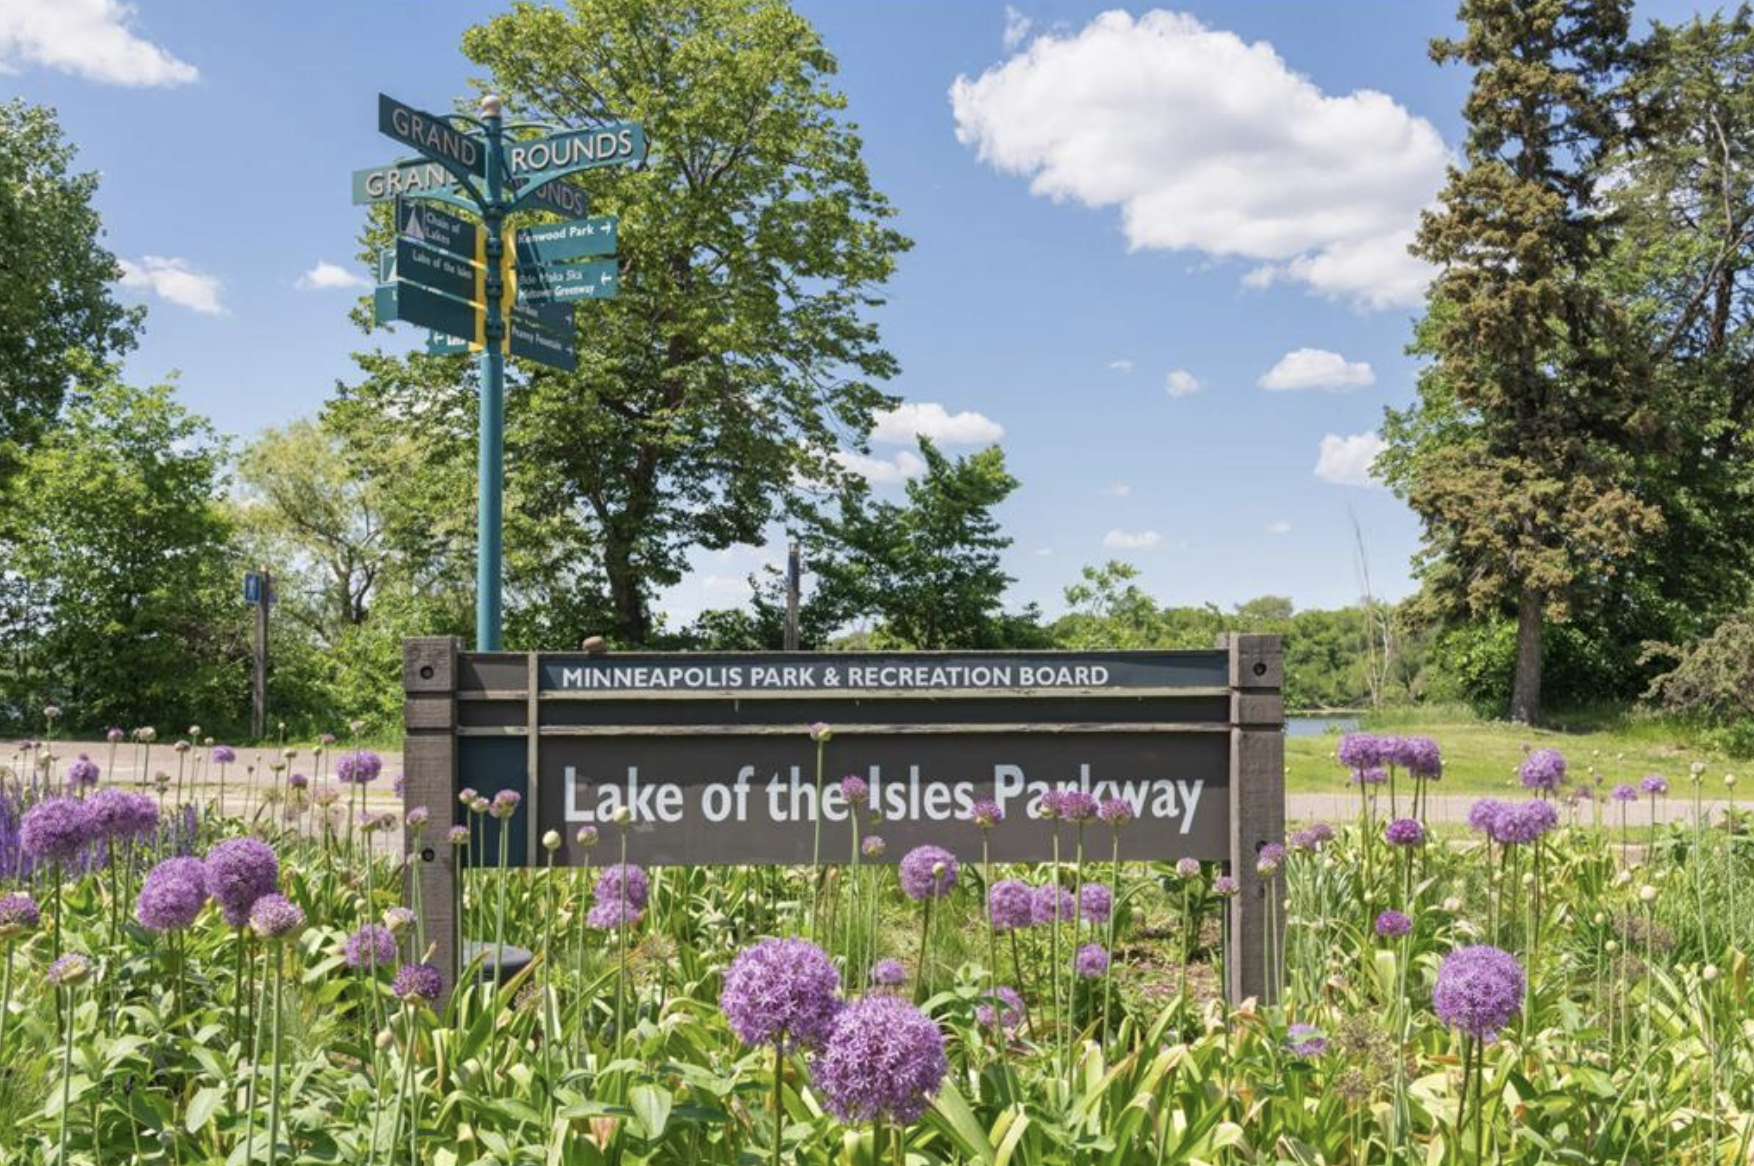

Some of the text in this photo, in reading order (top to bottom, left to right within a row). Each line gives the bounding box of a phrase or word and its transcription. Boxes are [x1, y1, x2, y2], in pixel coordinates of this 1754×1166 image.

[392, 108, 477, 167] GRAND
[511, 128, 633, 173] ROUNDS
[569, 222, 595, 238] Park
[554, 284, 595, 298] Greenway
[562, 666, 1109, 688] MINNEAPOLIS PARK & RECREATION BOARD
[564, 765, 684, 823] Lake
[701, 765, 755, 822] of
[764, 765, 849, 823] the
[869, 764, 975, 821] Isles
